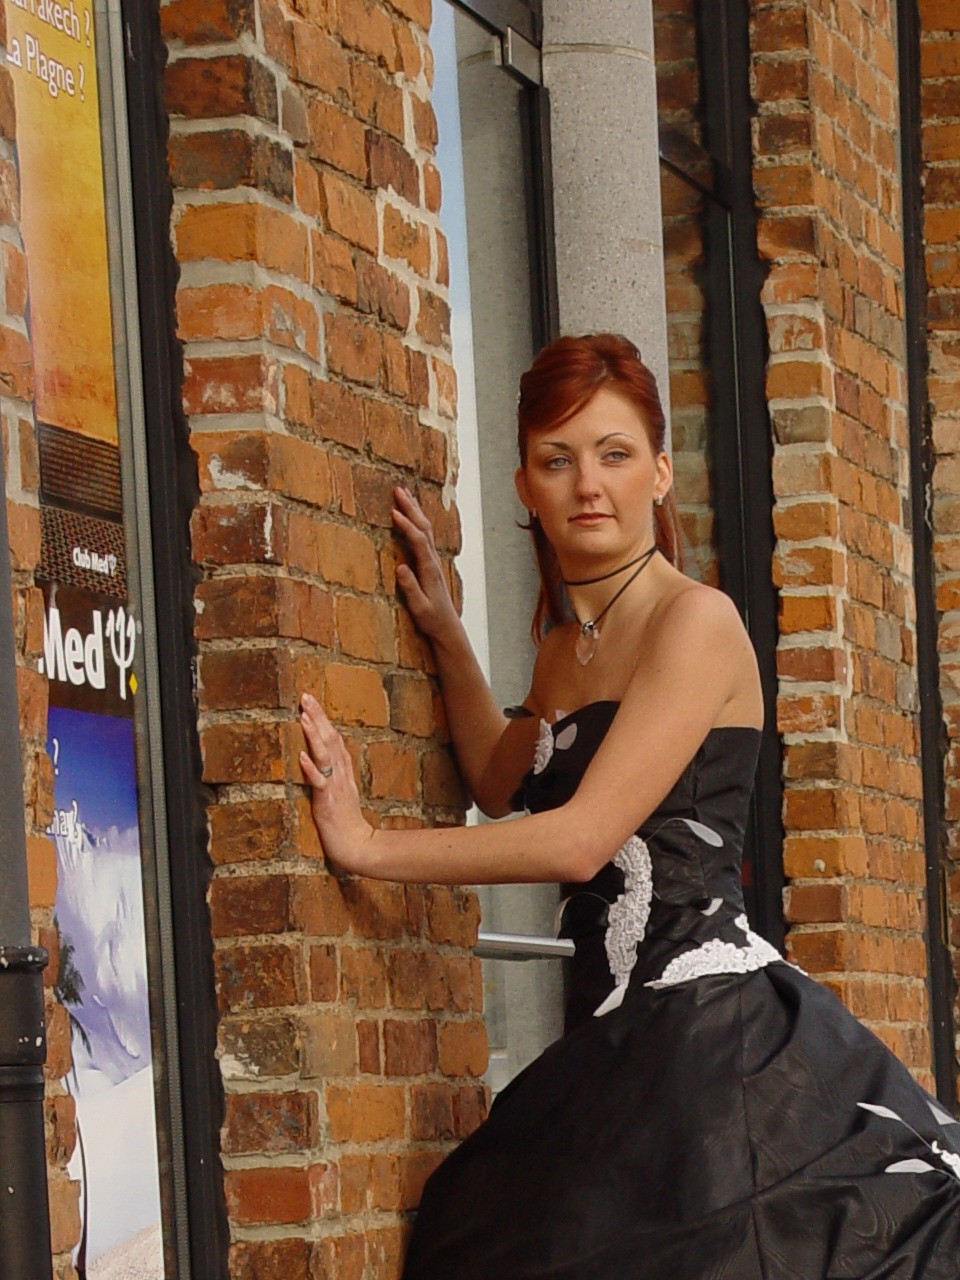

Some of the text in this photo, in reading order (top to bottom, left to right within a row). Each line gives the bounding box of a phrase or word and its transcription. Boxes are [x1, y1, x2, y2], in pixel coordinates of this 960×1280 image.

[25, 32, 75, 98] Plagne
[73, 546, 109, 575] Club Med
[43, 607, 106, 690] Med
